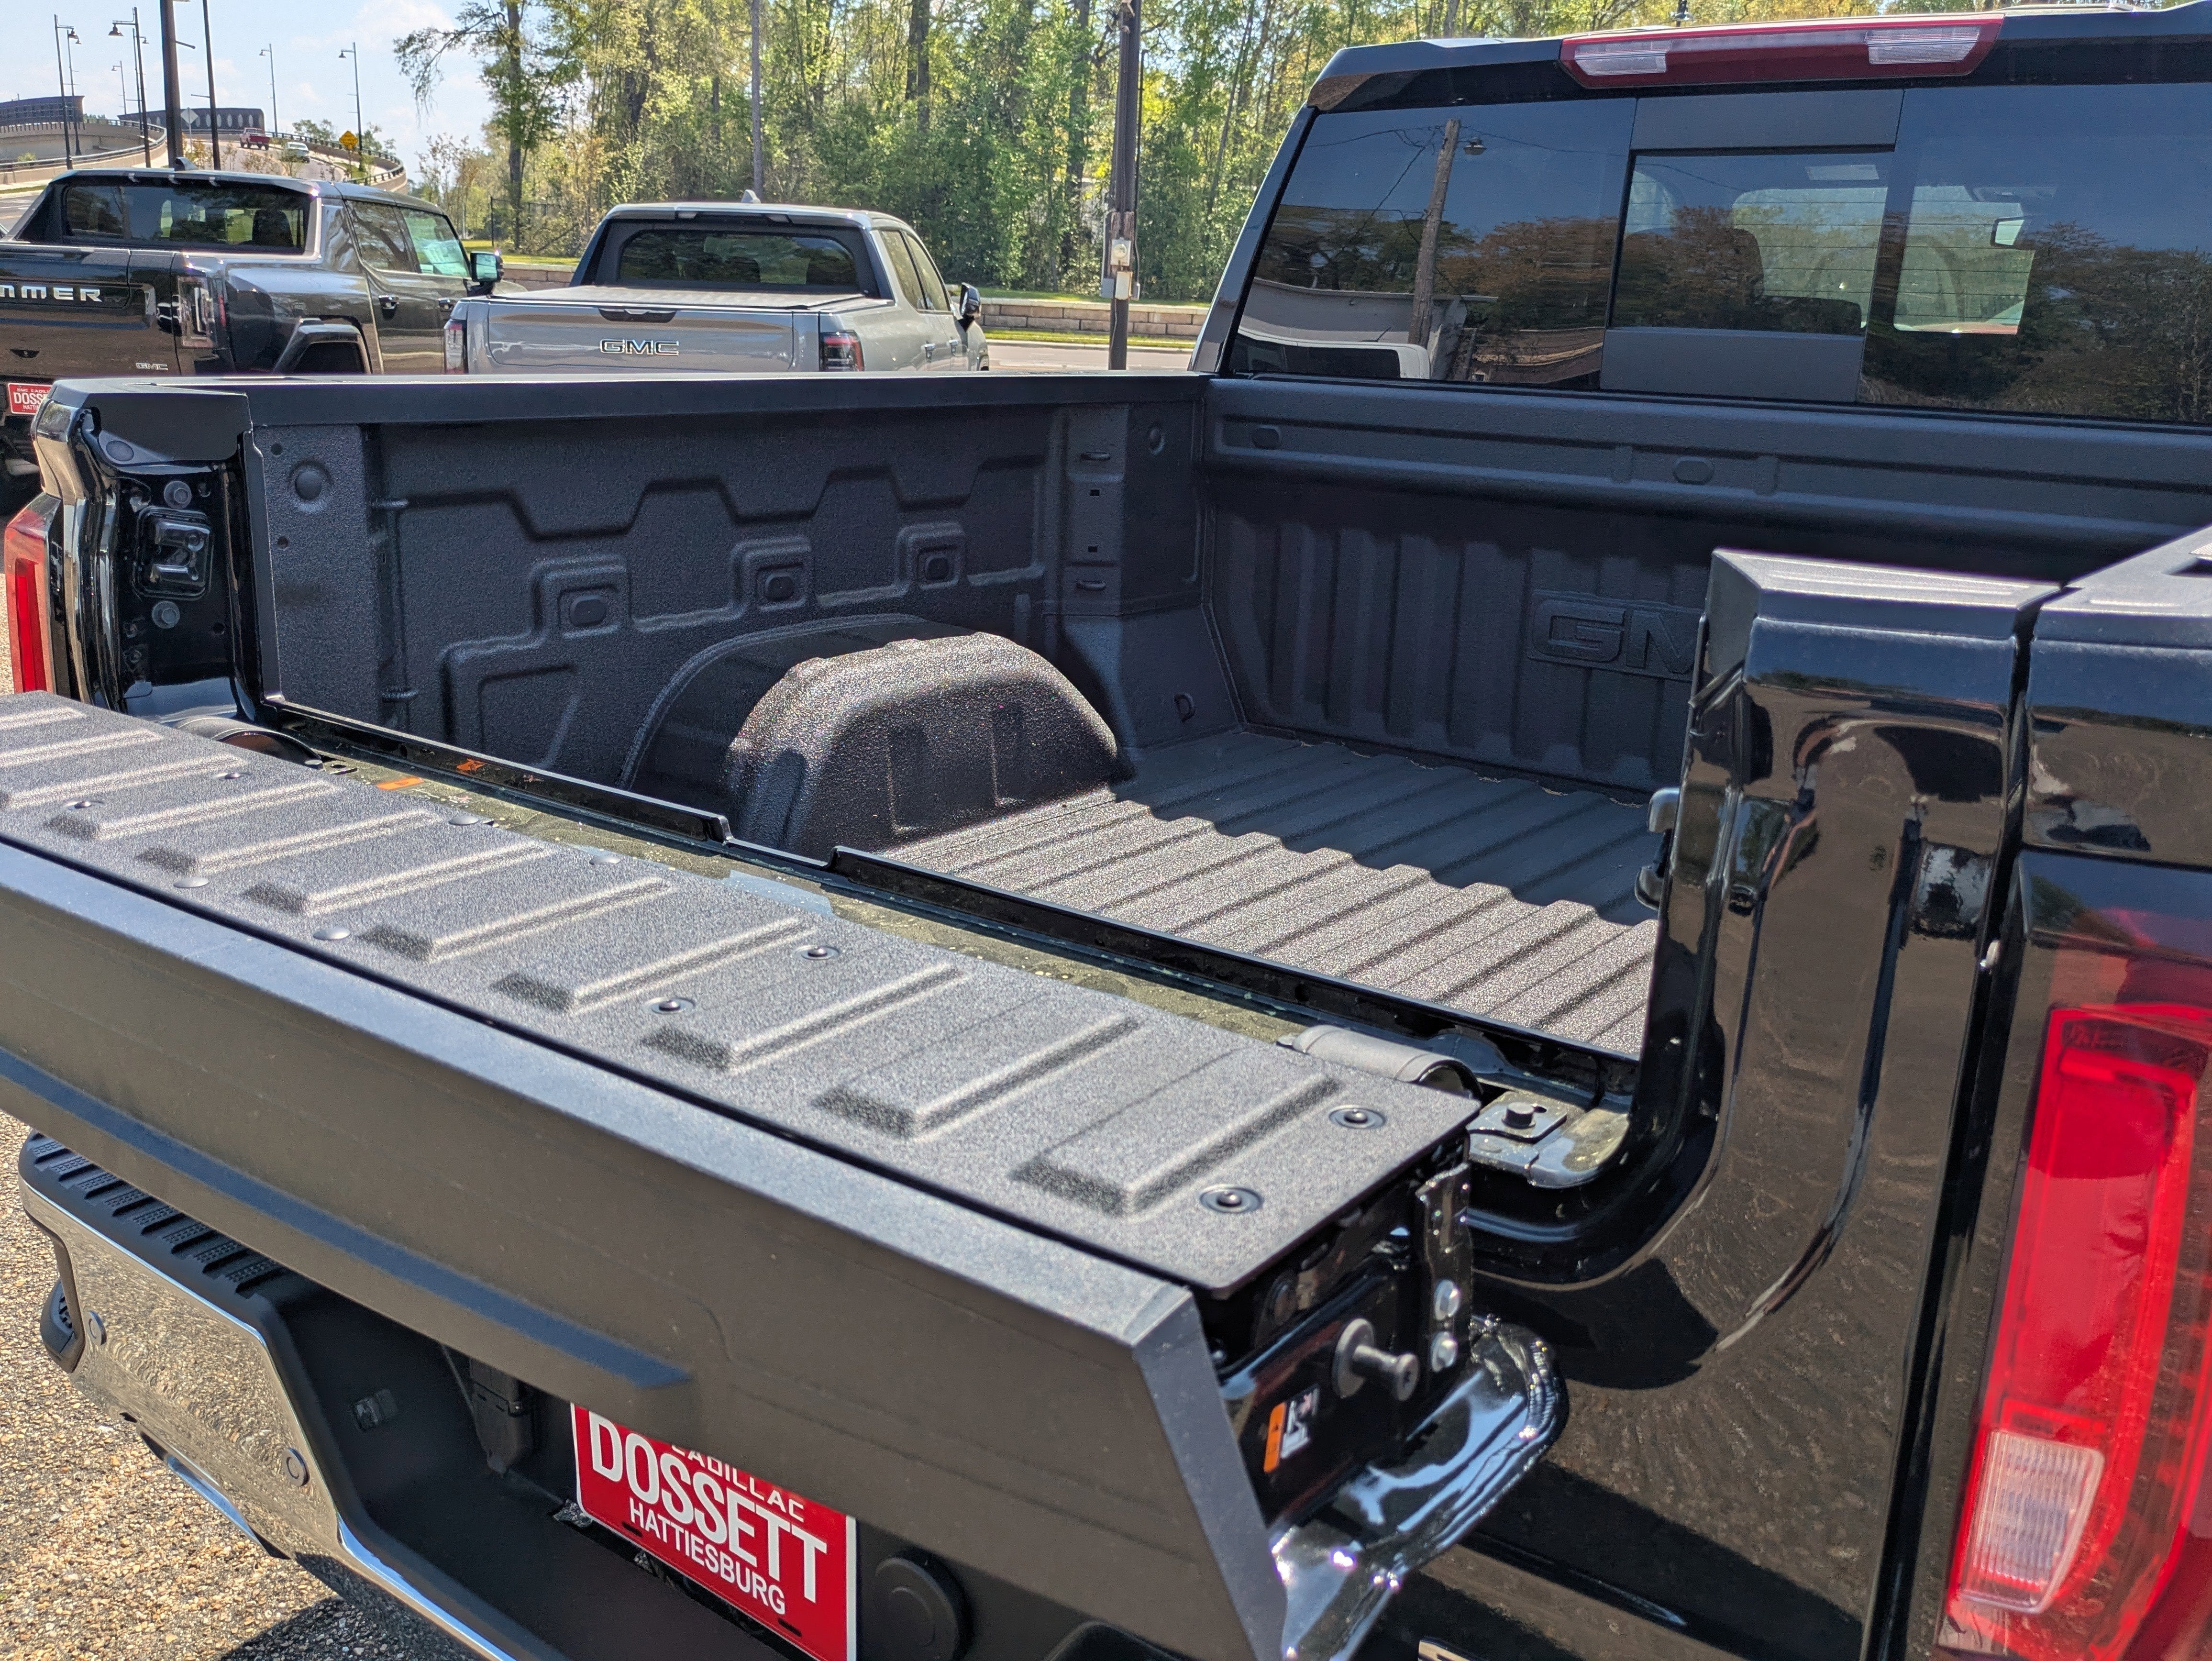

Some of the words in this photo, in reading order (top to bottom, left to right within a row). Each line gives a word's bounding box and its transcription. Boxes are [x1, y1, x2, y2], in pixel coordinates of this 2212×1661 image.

[135, 362, 168, 371] GMC
[599, 339, 679, 356] GMC
[588, 1410, 828, 1604] DOSSETT
[629, 1497, 785, 1616] HATTIESBURG
